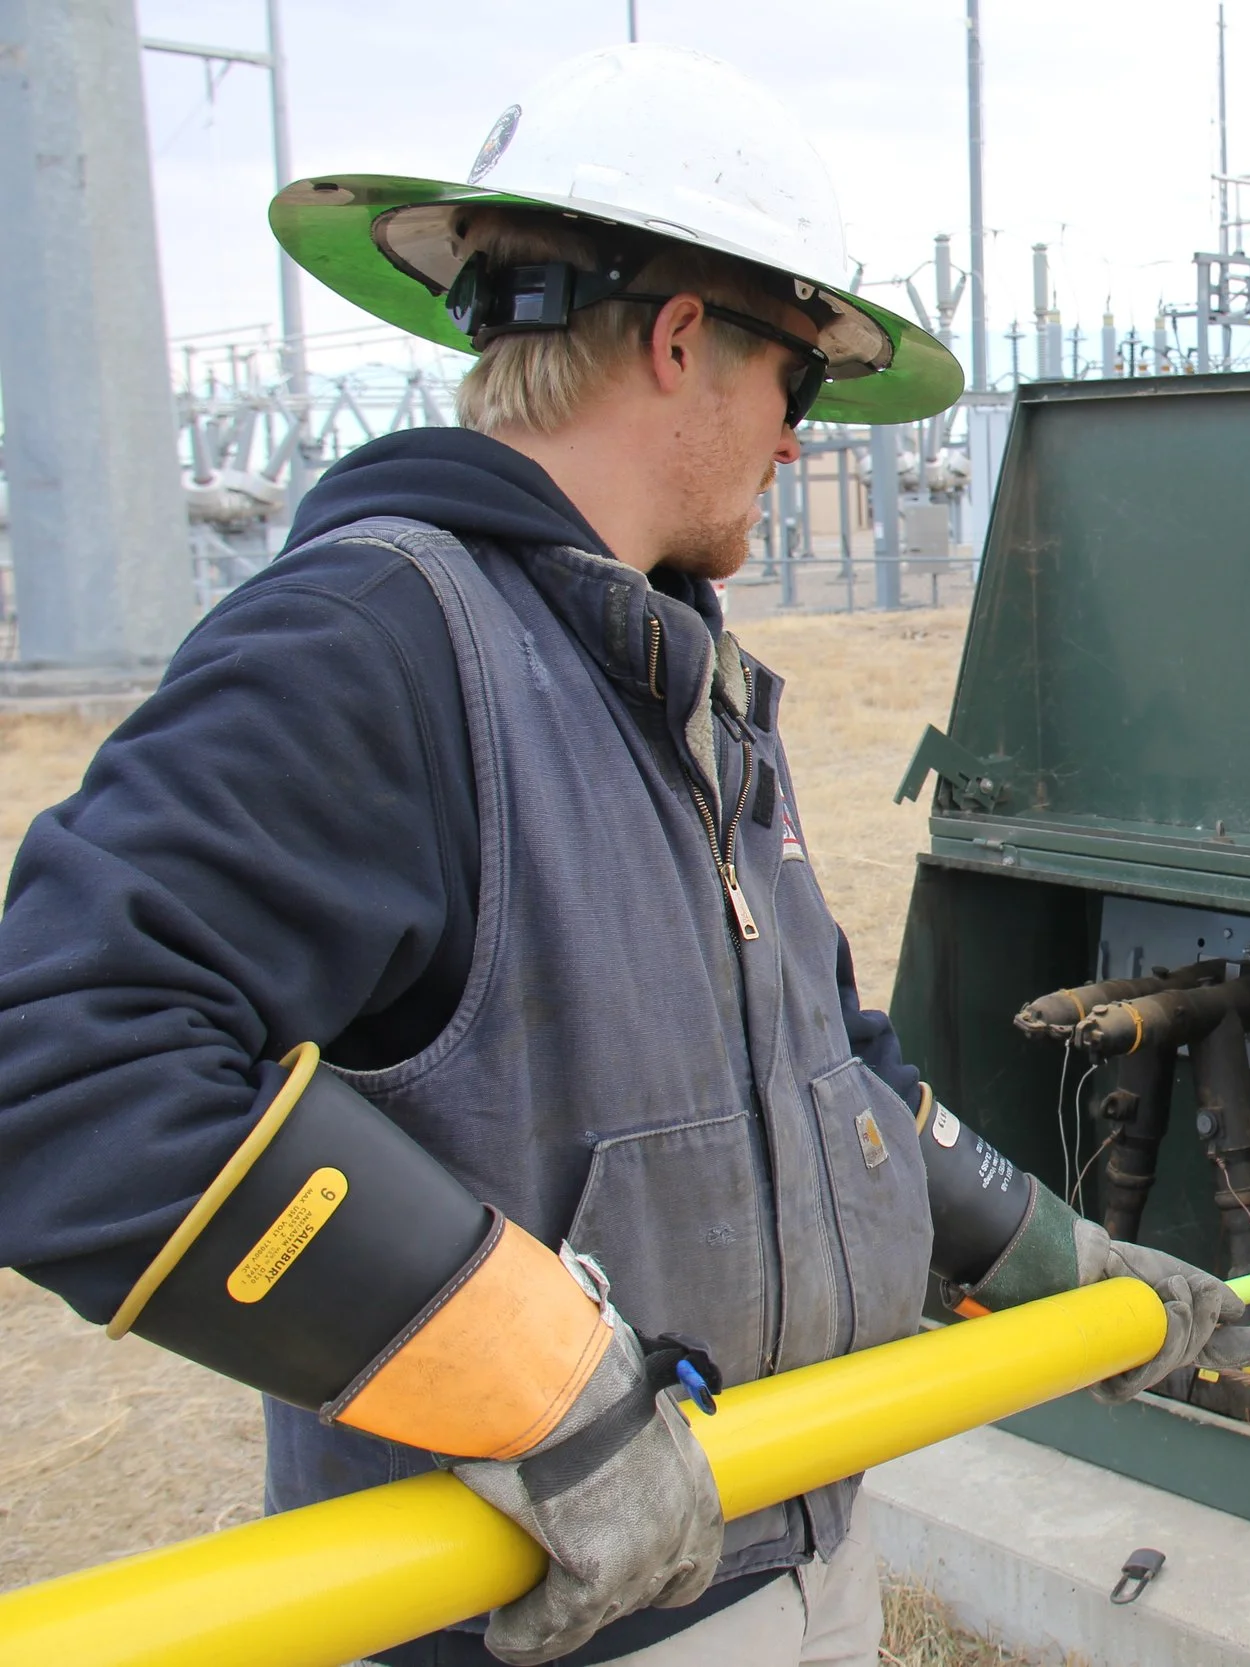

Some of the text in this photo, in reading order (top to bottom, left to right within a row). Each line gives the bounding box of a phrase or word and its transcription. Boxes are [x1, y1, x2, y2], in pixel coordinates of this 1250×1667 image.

[981, 1152, 992, 1172] CLASS
[321, 1187, 336, 1201] 9
[1001, 1177, 1009, 1192] LAB
[288, 1207, 307, 1228] CLASS
[242, 1188, 313, 1273] MAX USE VOLT 17000V AC
[251, 1211, 312, 1284] ANSI/ASTM D120
[266, 1225, 314, 1283] SALISBURY
[246, 1263, 261, 1278] TYPE
